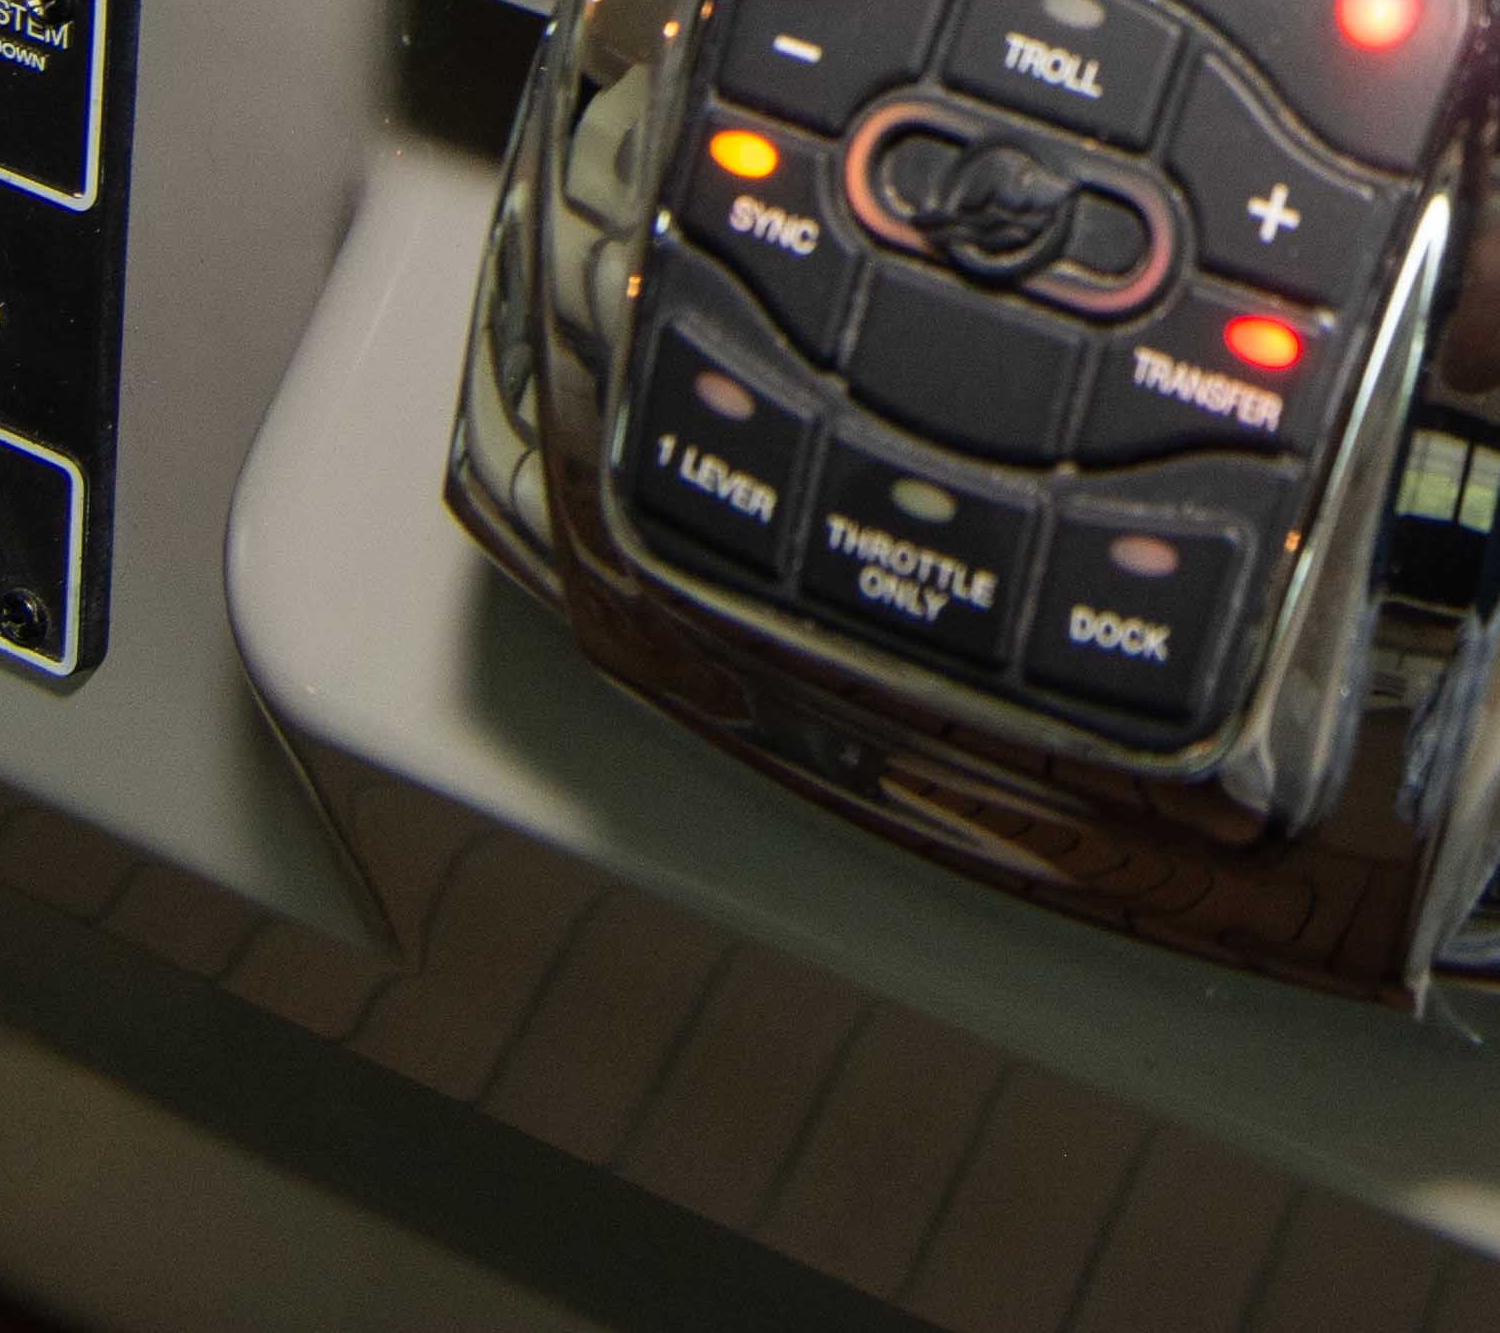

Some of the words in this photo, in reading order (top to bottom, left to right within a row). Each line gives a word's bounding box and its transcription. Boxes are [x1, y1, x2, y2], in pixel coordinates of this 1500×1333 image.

[1004, 31, 1104, 101] TROLL
[728, 194, 822, 257] SYNC
[1132, 346, 1285, 434] TRANSFER
[655, 435, 676, 467] 1
[677, 444, 778, 524] LEVER
[824, 512, 999, 612] THROTTLE
[857, 565, 953, 624] ONLY
[1067, 605, 1173, 664] DOCK
